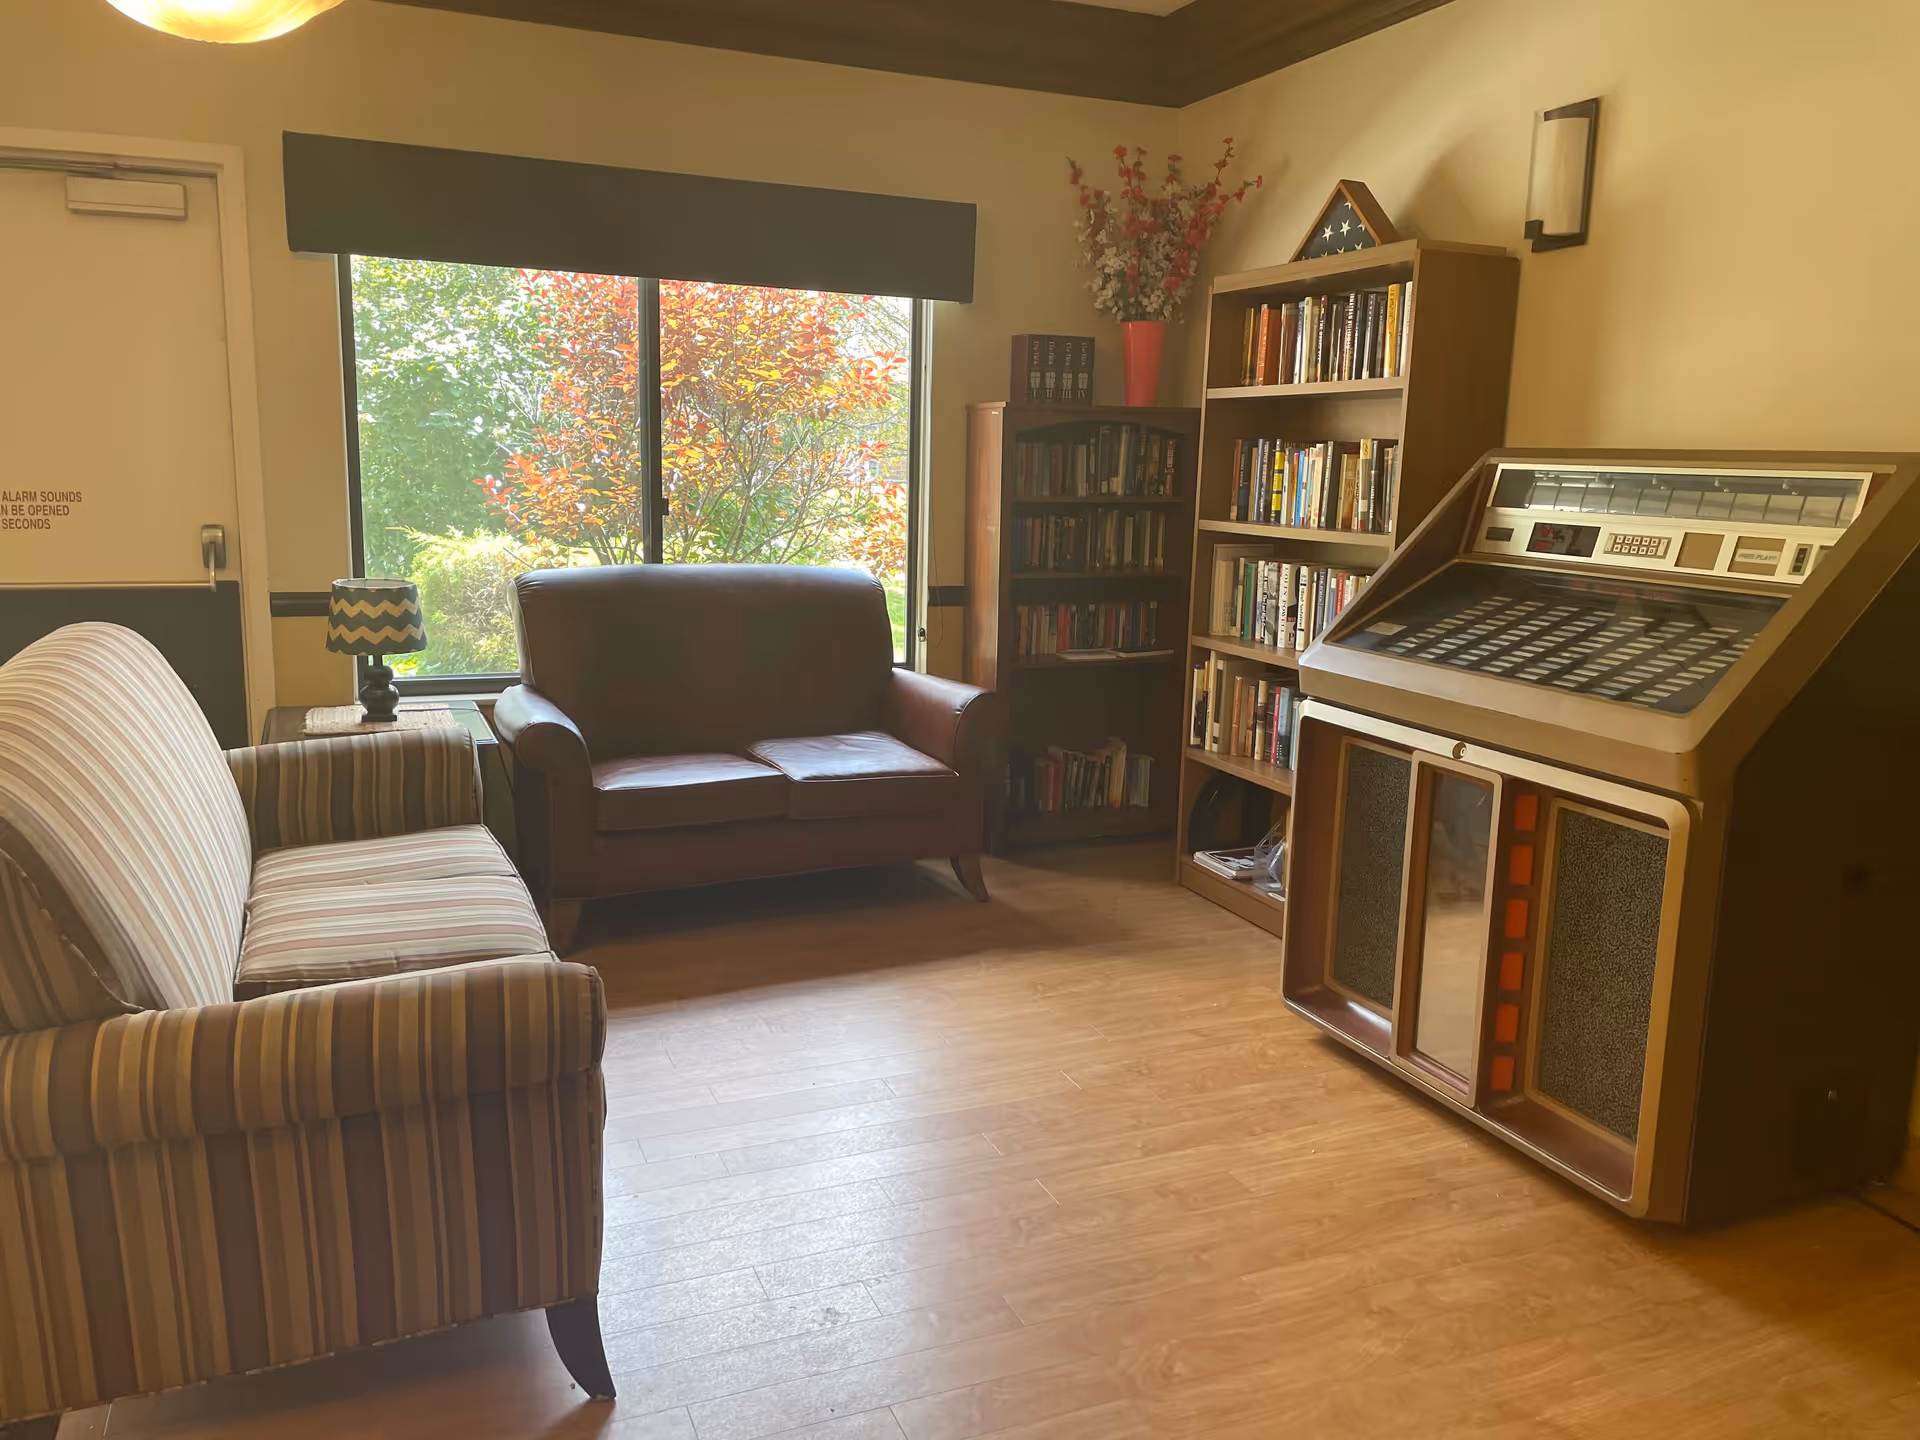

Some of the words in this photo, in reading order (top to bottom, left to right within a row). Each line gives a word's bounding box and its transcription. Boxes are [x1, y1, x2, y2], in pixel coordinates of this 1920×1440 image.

[2, 490, 37, 502] ALARM
[40, 491, 82, 502] SOUNDS
[11, 504, 25, 516] BE
[28, 504, 70, 516] OPENED
[2, 518, 51, 530] SECONDS
